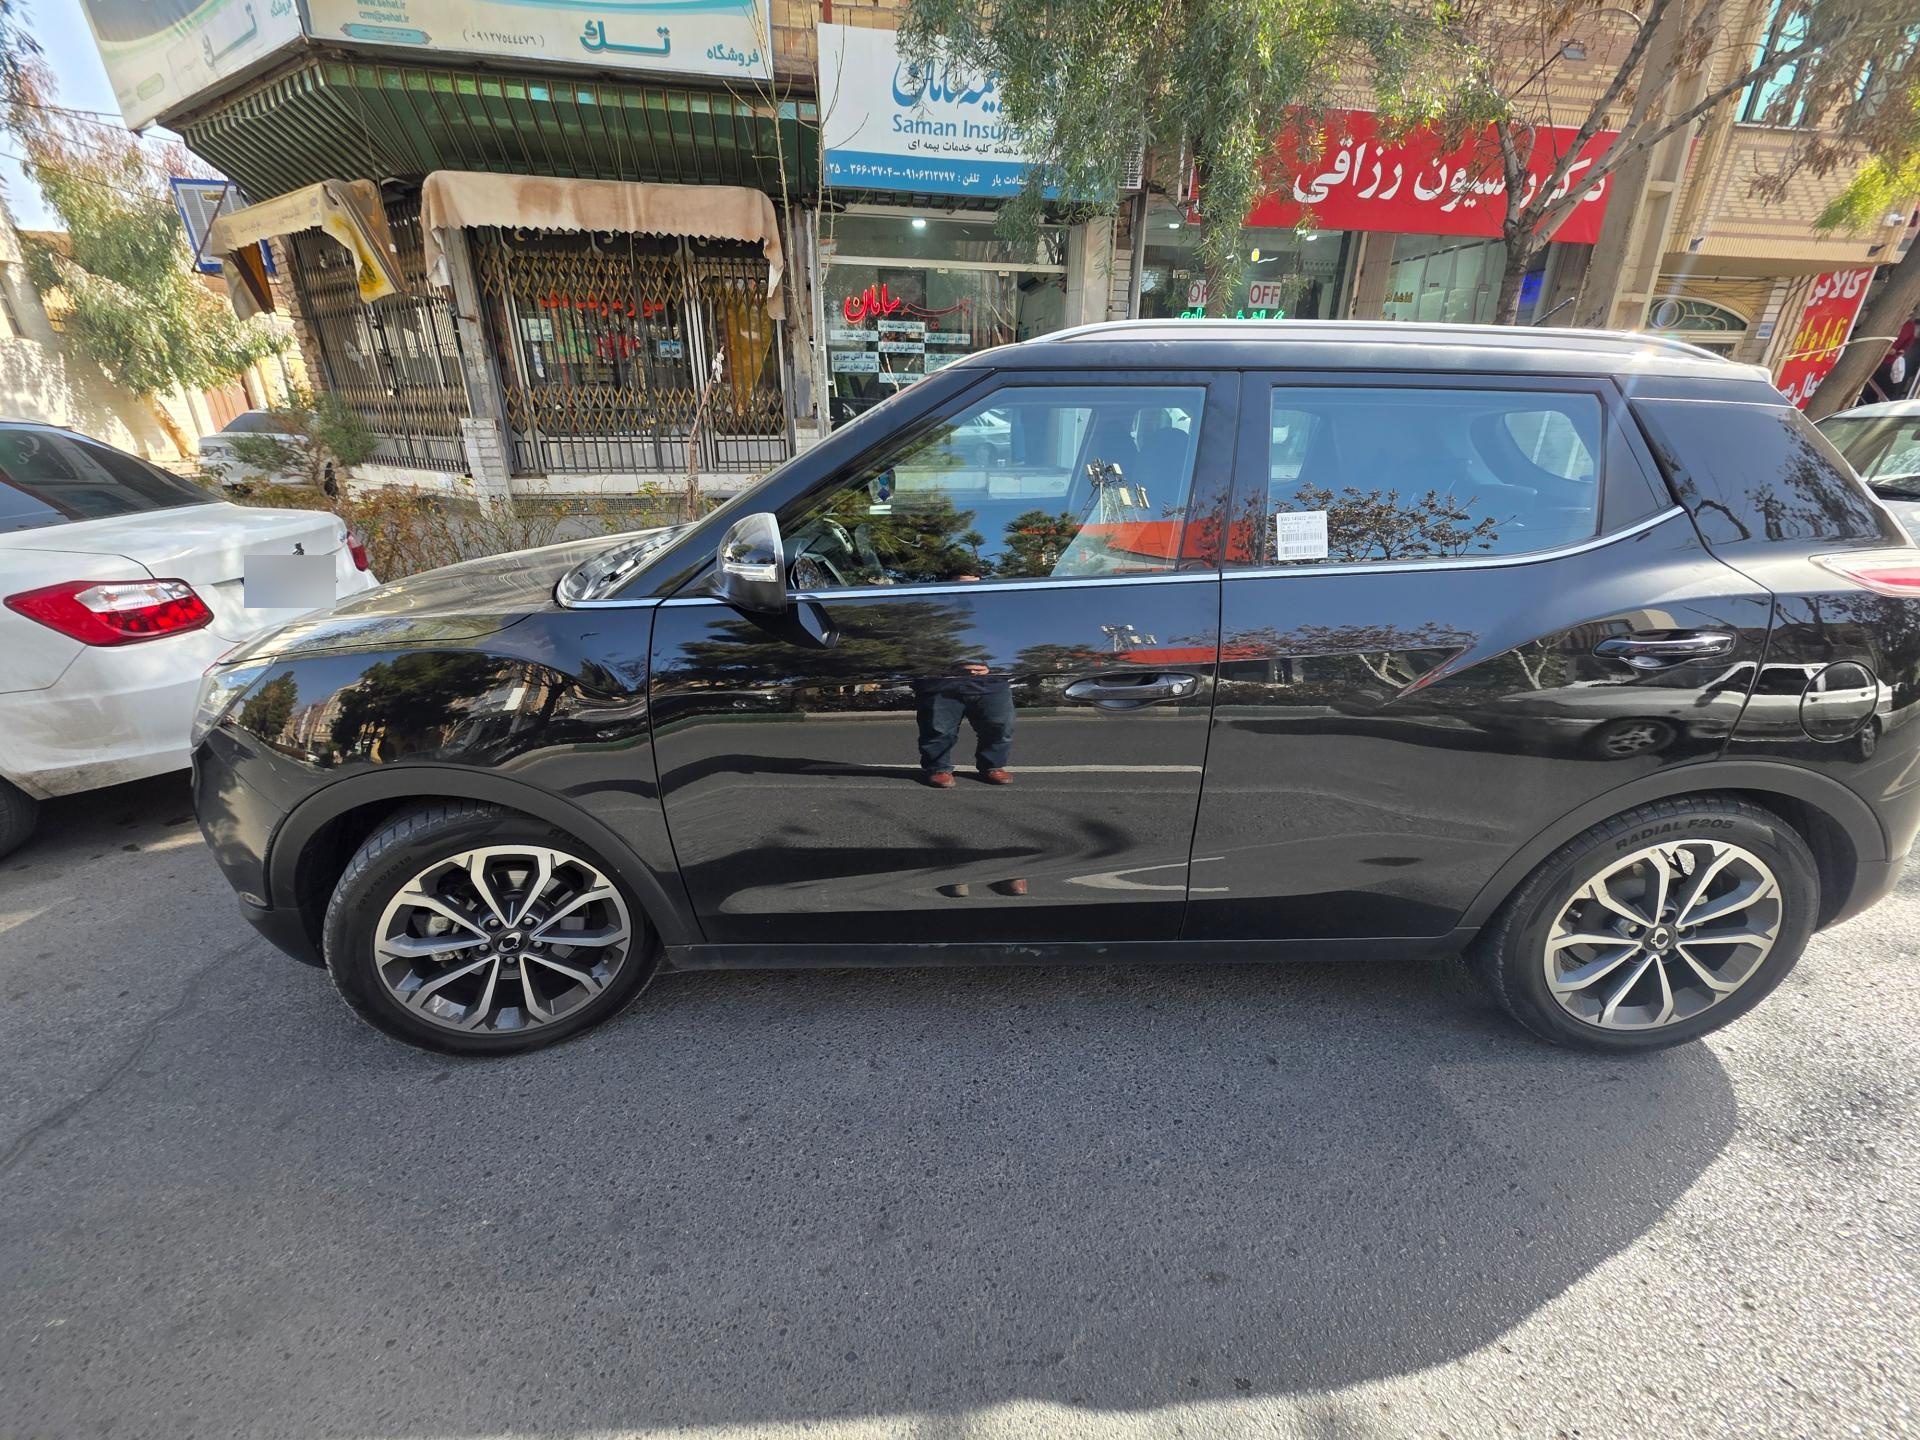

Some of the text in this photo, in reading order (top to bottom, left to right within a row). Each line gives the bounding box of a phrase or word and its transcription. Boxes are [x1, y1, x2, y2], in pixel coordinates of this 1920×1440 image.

[706, 44, 759, 67] فروشگاه
[892, 114, 957, 137] Saman
[907, 139, 921, 150] ای
[923, 140, 940, 152] بیمه
[943, 142, 971, 152] خدمات
[975, 143, 991, 154] کلیه
[962, 174, 980, 186] تلفن
[1293, 137, 1402, 203] رزاقی
[1250, 284, 1280, 304] OFF
[1807, 270, 1869, 307] کالابر
[843, 283, 901, 323] سامان
[833, 353, 850, 361] سوزی
[1615, 818, 1736, 850] RADIAL F205
